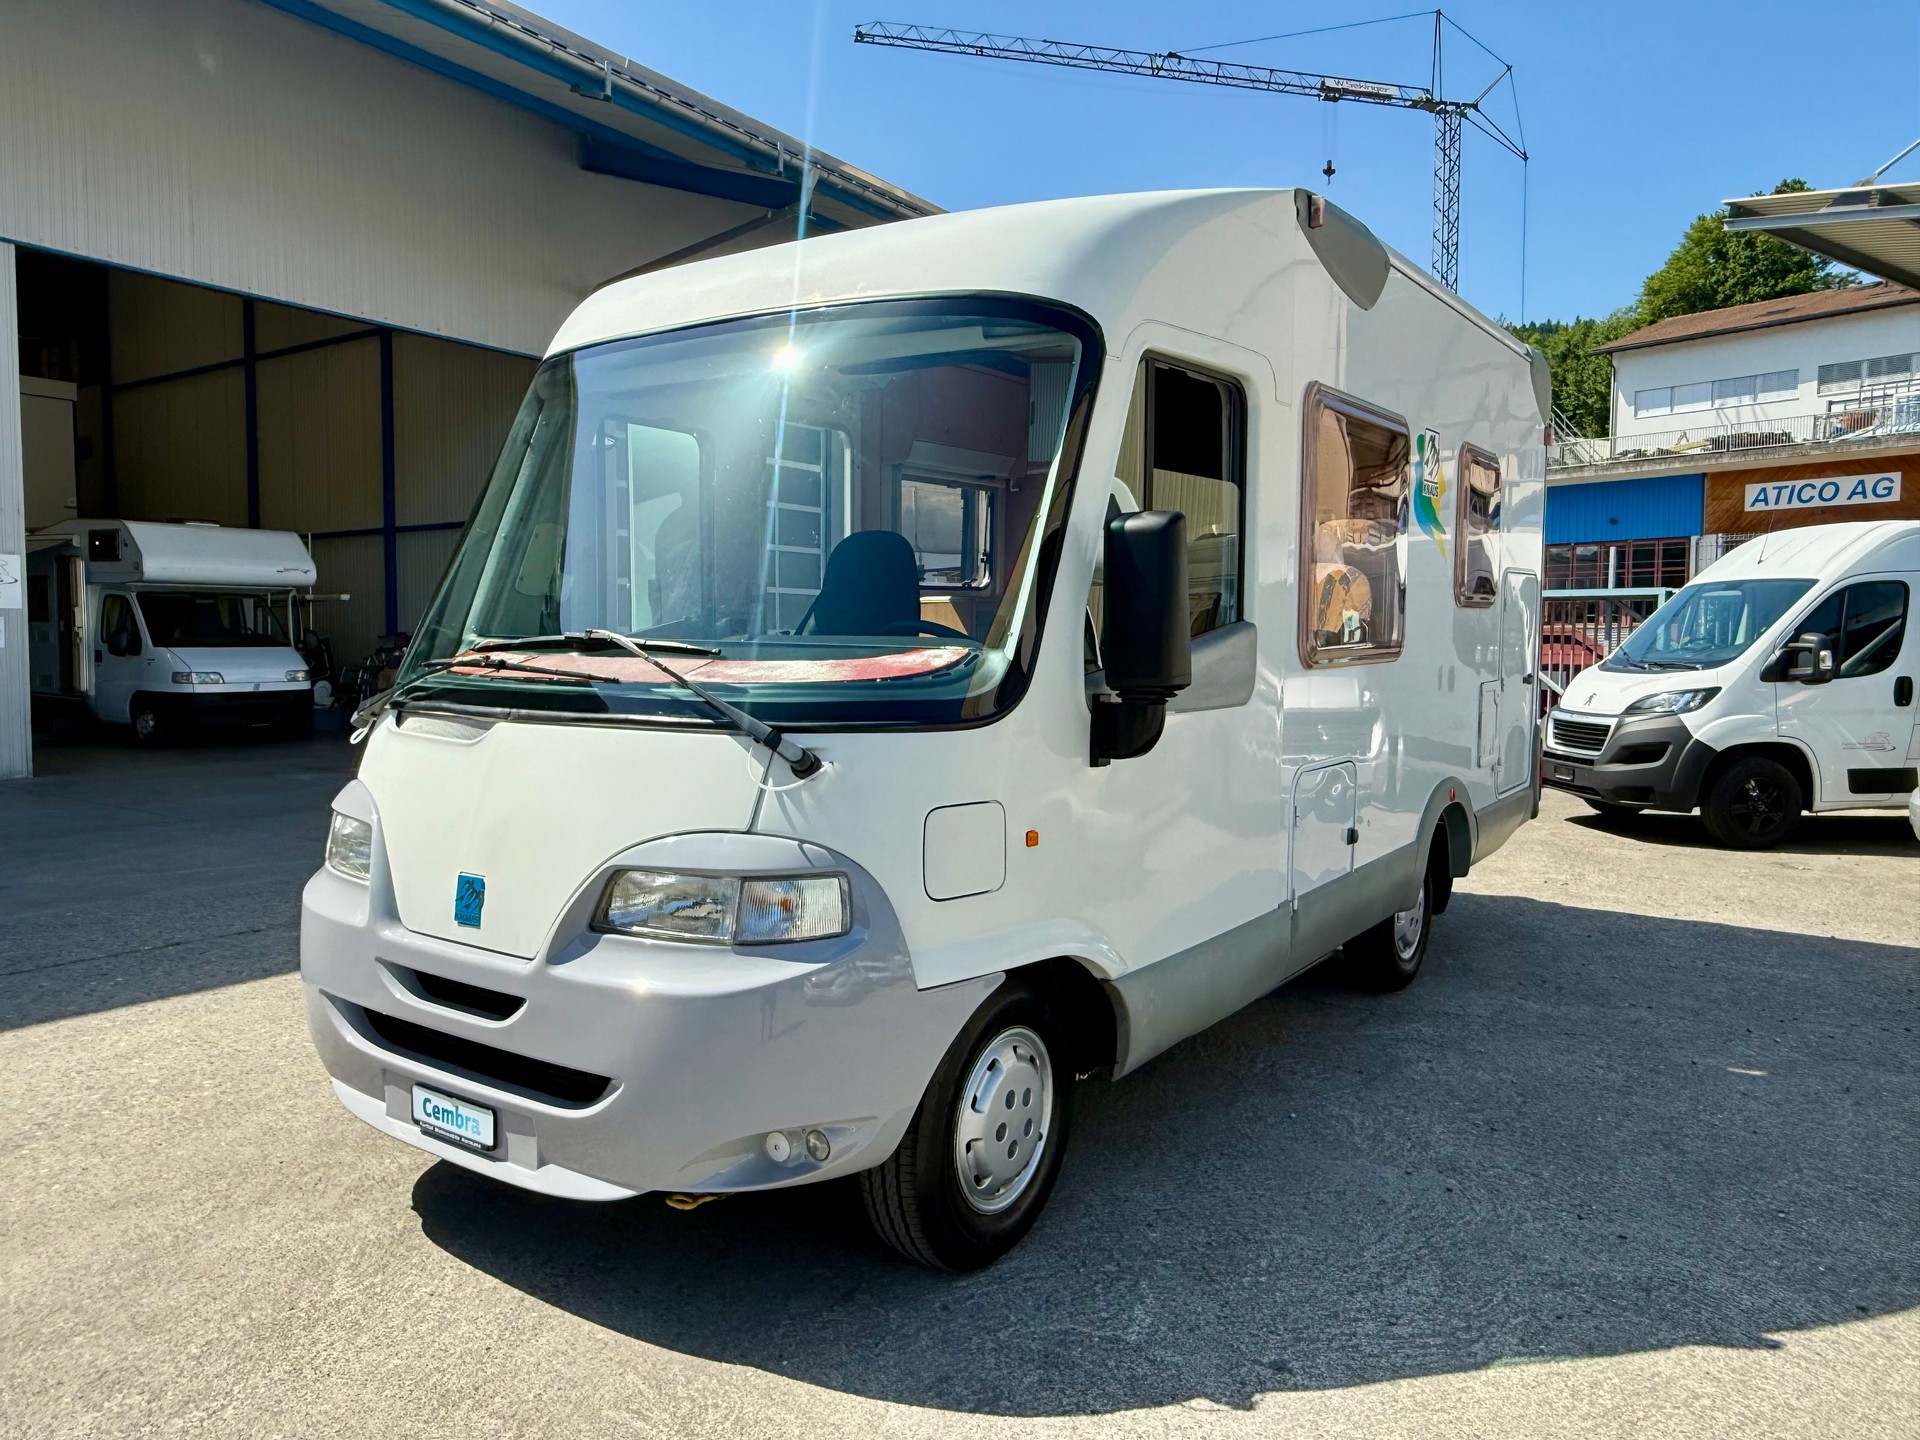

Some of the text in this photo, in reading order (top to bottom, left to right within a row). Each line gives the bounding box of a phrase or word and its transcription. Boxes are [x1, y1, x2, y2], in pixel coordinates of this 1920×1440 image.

[1749, 477, 1895, 508] ATICO AG
[422, 1097, 481, 1136] Cembra
